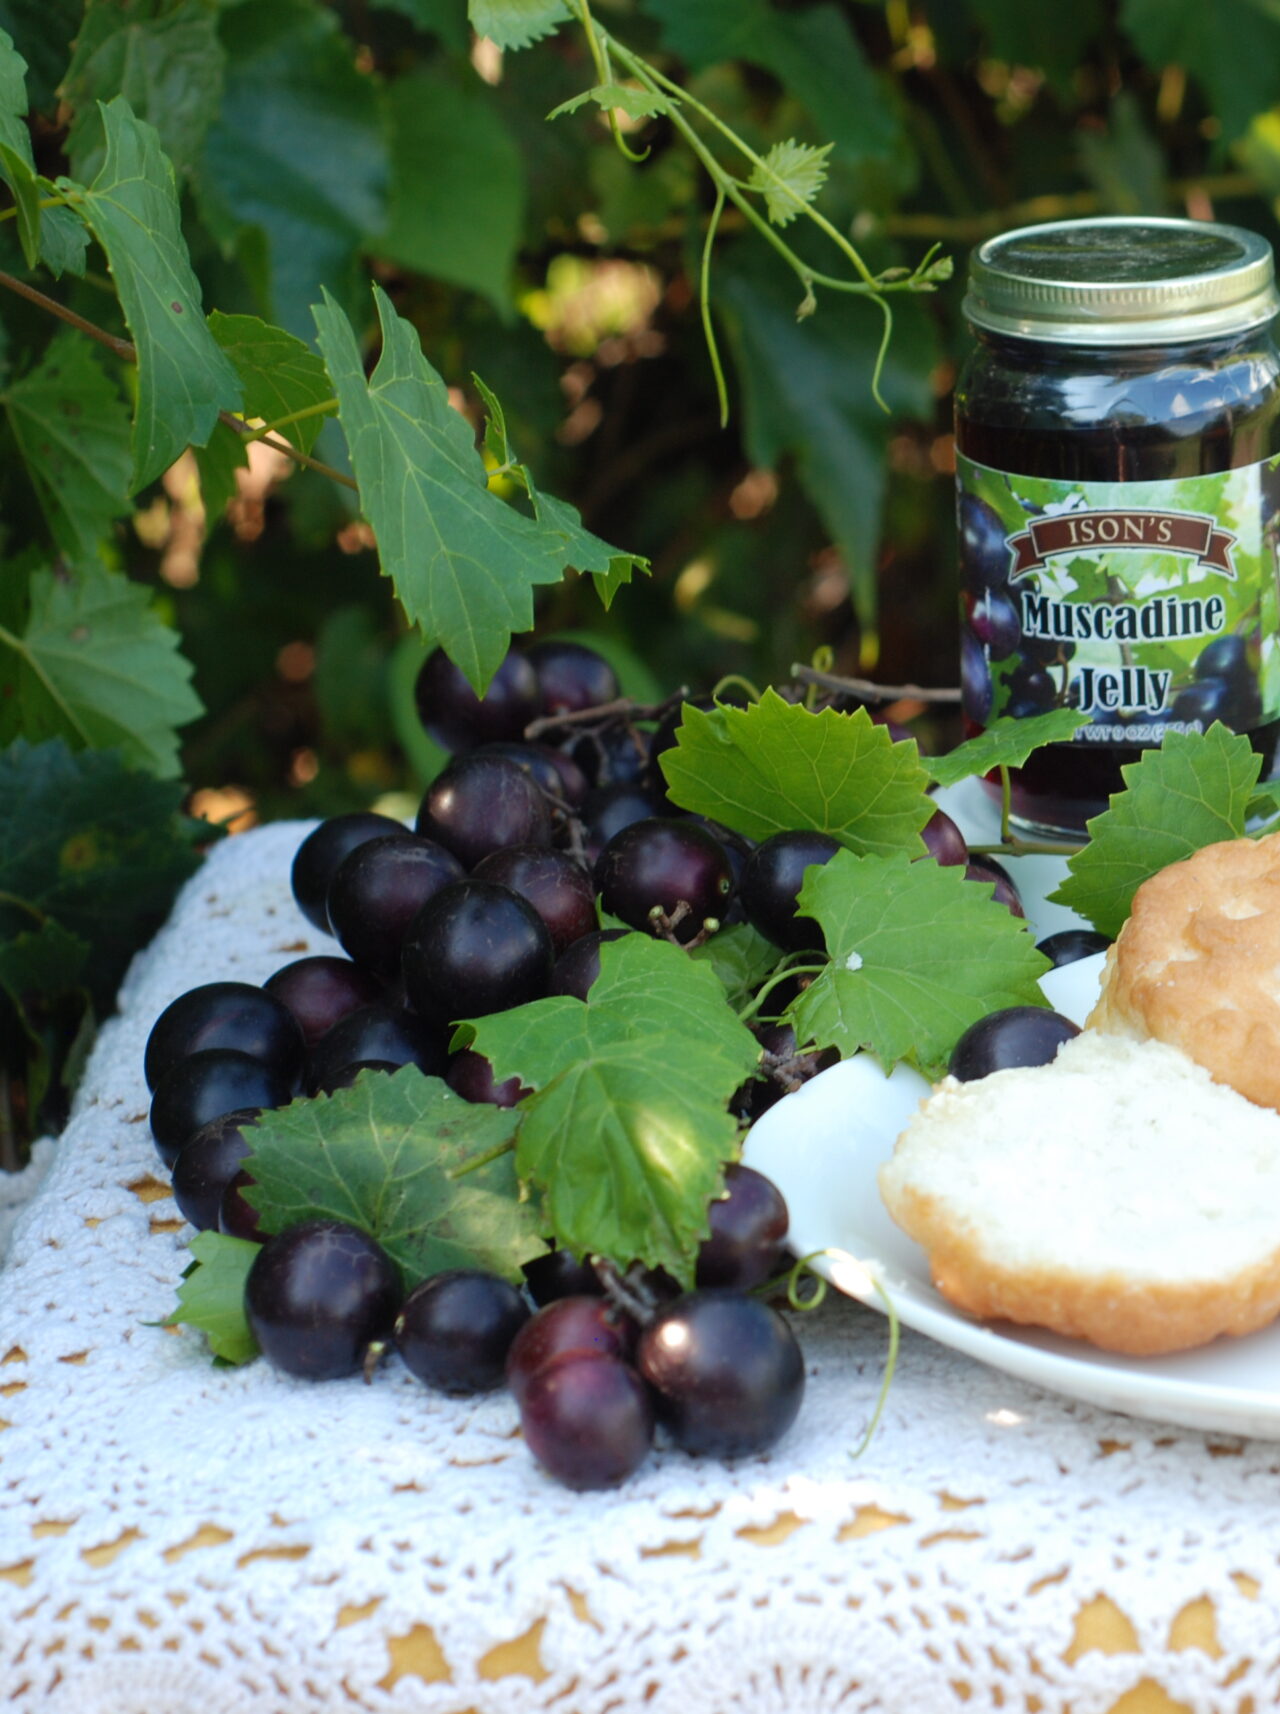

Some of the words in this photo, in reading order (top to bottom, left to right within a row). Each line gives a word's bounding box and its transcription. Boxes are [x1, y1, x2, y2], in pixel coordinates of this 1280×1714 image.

[1067, 517, 1173, 544] ISON'S
[1022, 593, 1225, 641] Muscadine
[1079, 667, 1170, 712] Jelly
[1126, 723, 1151, 741] OZ
